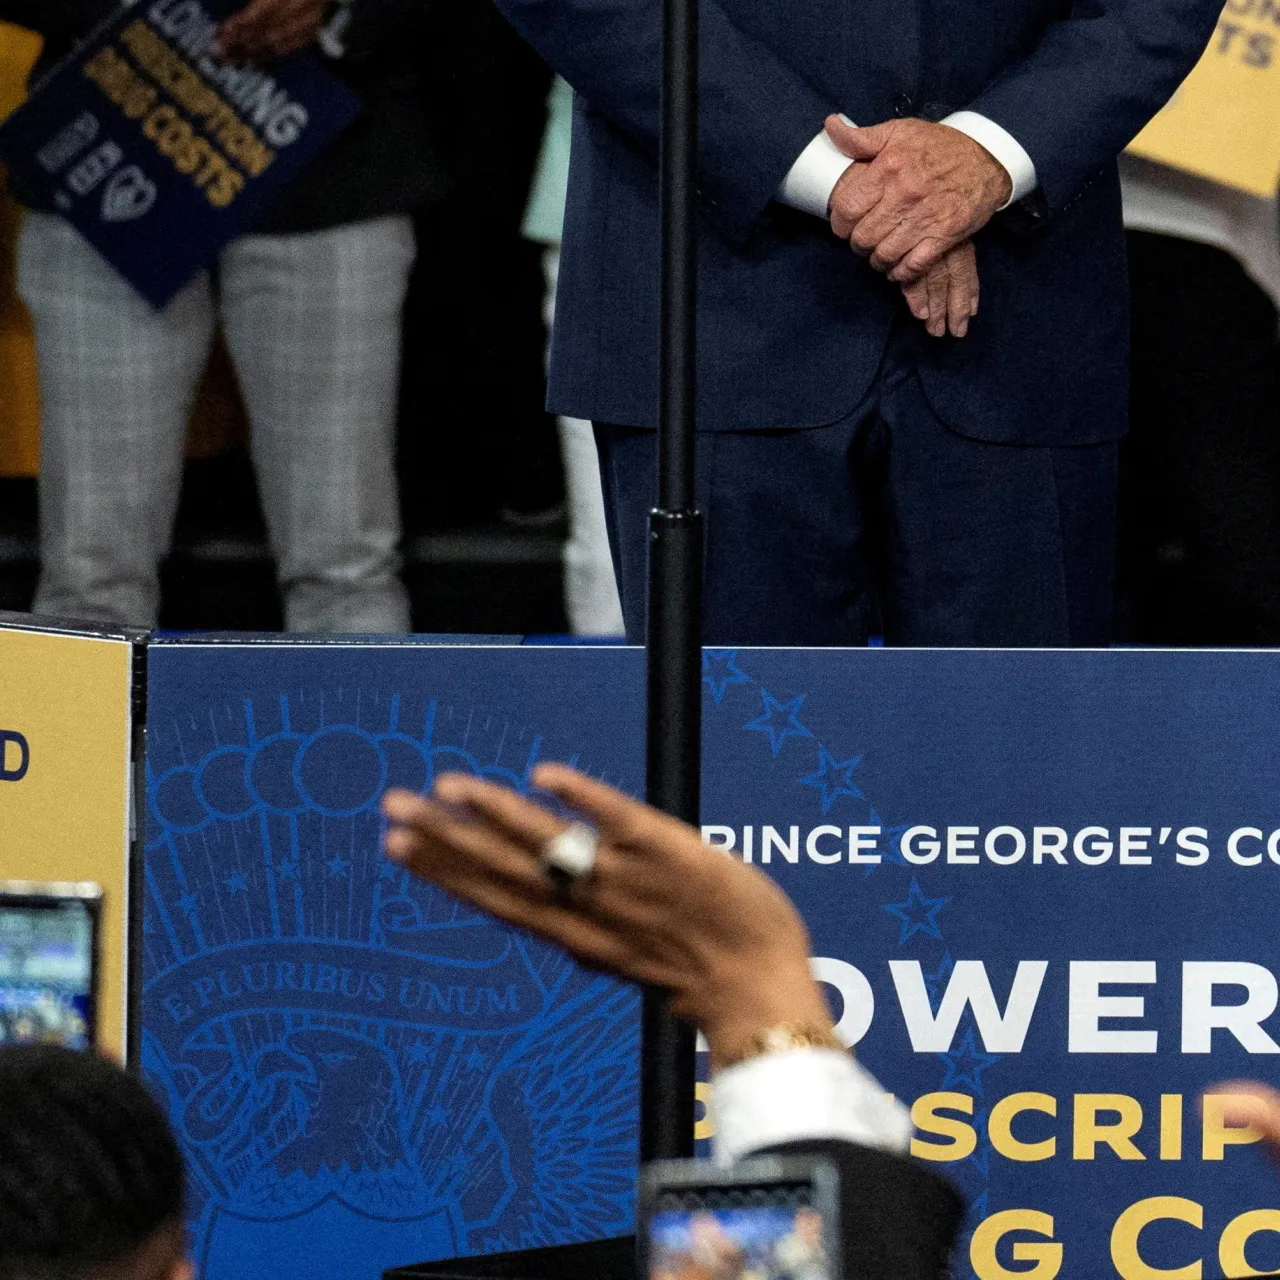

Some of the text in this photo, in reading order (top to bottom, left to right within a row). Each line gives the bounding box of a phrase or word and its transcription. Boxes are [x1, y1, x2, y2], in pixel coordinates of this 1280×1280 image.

[701, 824, 880, 866] RINCE
[899, 825, 1209, 867] GEORGE'S
[164, 960, 521, 1022] E PLURIBUS UNUM
